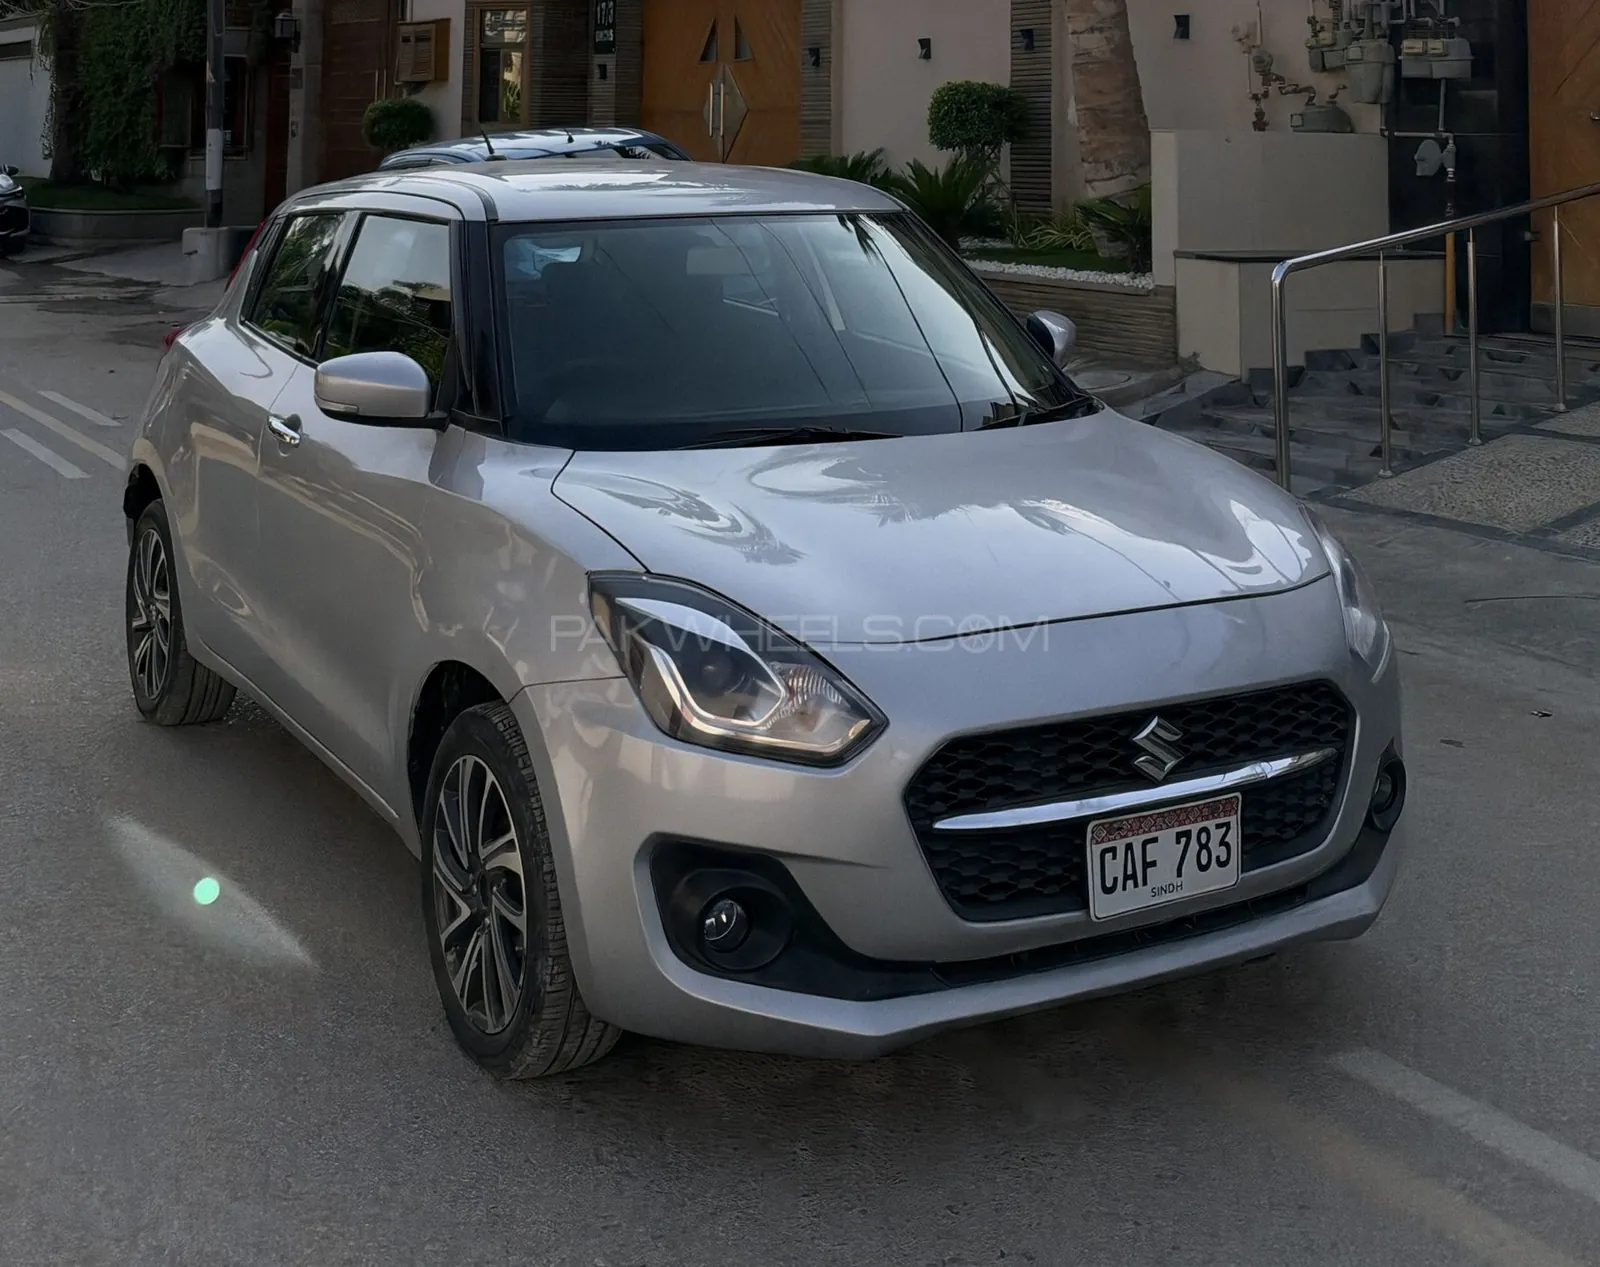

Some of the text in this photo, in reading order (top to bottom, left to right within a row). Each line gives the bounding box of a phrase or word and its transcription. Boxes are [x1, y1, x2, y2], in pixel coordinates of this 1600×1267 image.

[1100, 821, 1232, 895] CAF 783
[1150, 881, 1184, 898] SINDH
